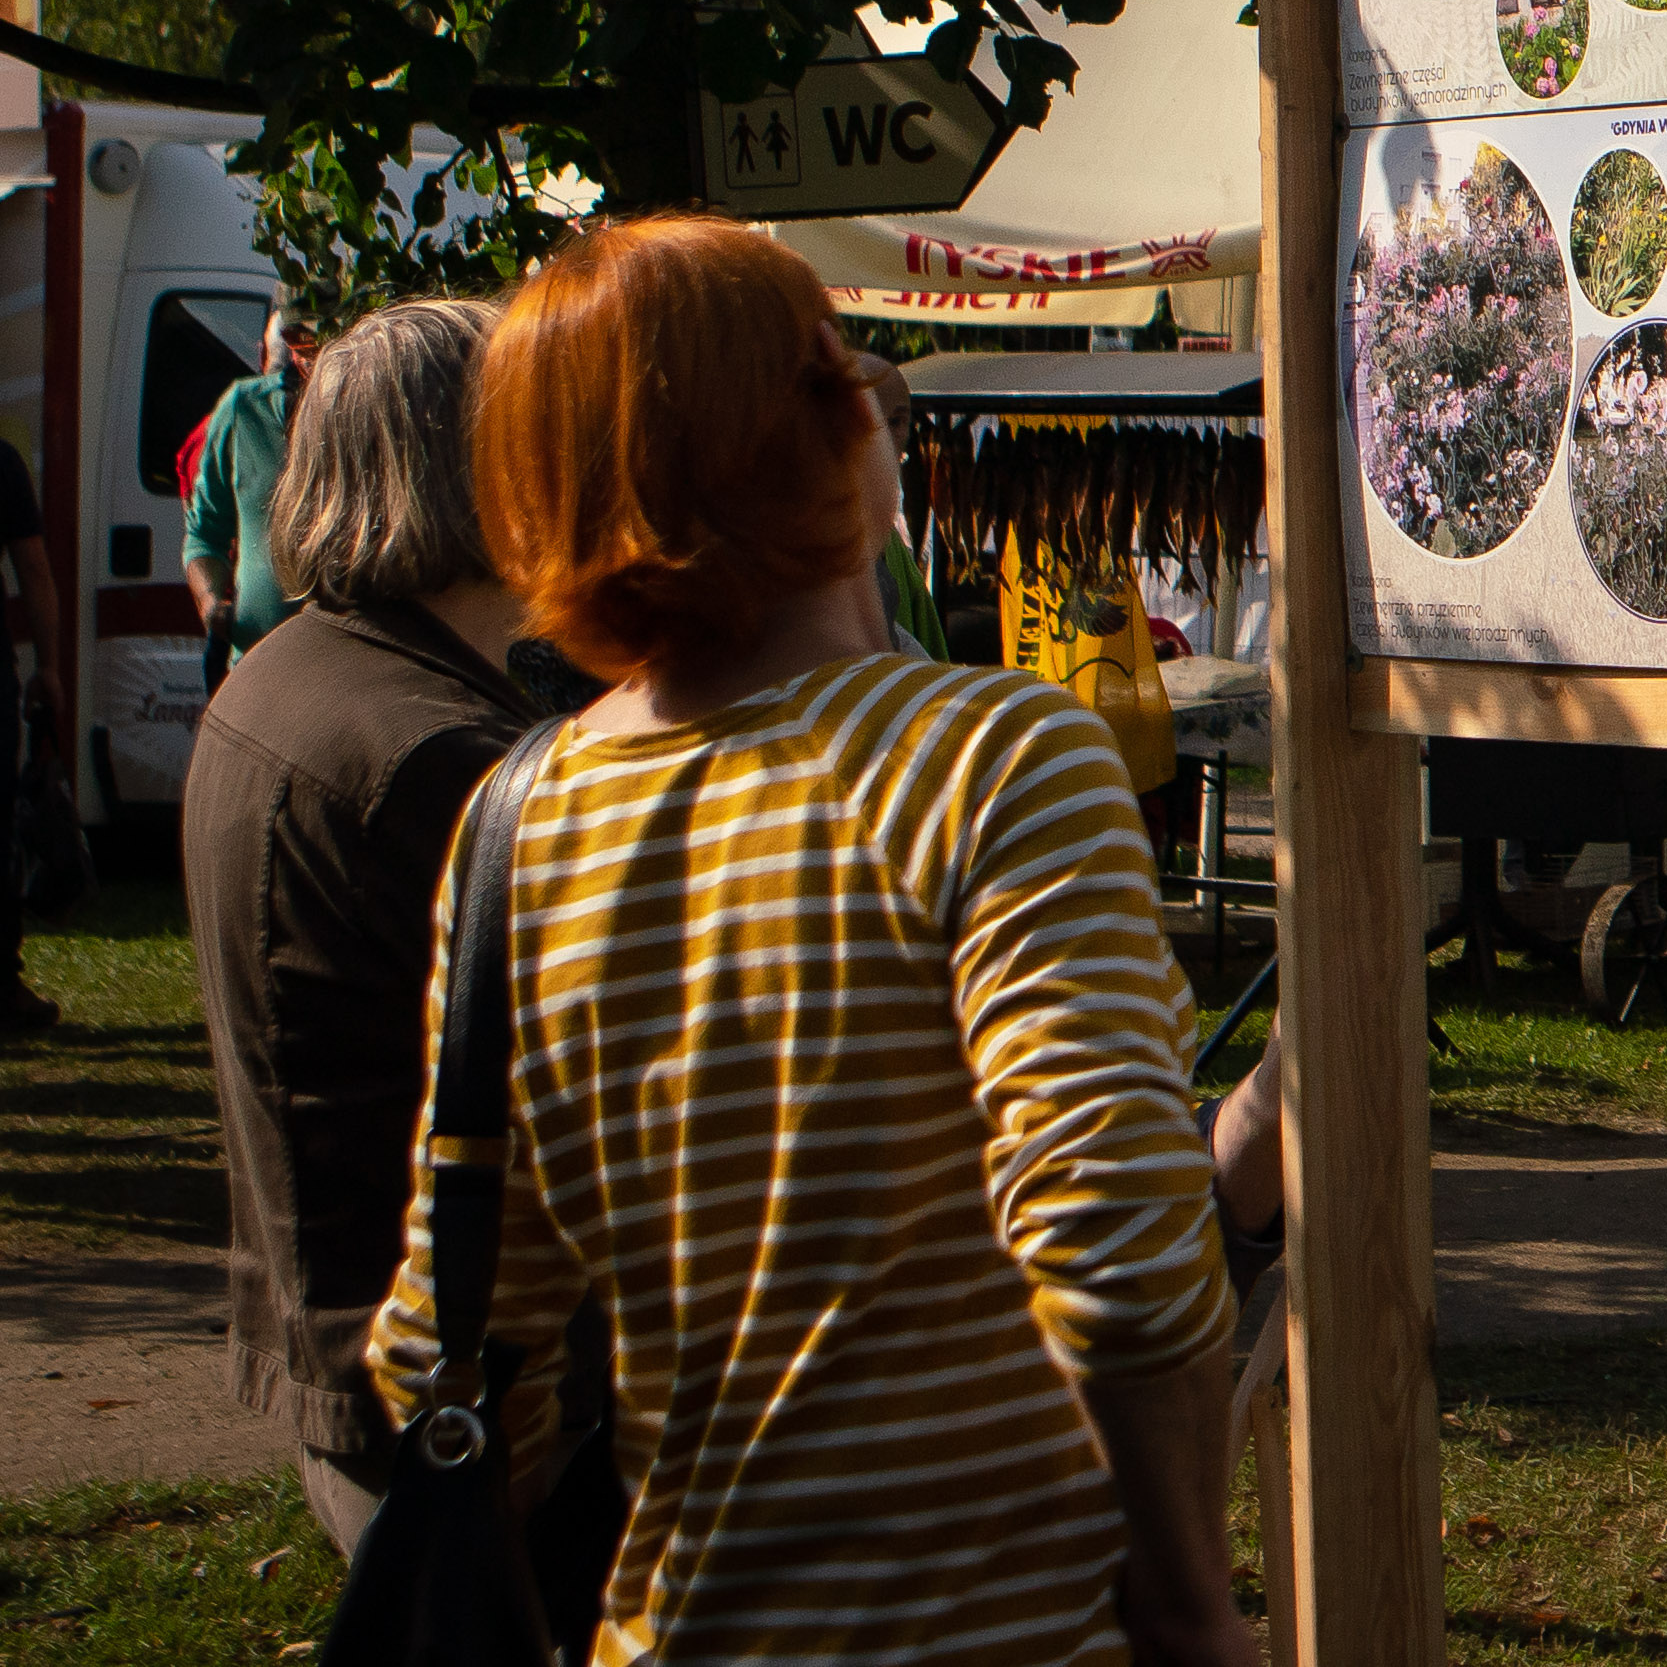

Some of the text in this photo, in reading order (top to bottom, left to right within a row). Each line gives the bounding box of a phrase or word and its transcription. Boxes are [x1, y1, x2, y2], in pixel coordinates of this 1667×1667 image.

[1349, 63, 1445, 91] Zewnętrzne części
[1409, 82, 1507, 112] jednorodzinnych
[822, 100, 937, 166] WC
[1610, 119, 1655, 136] 'GDYNIA
